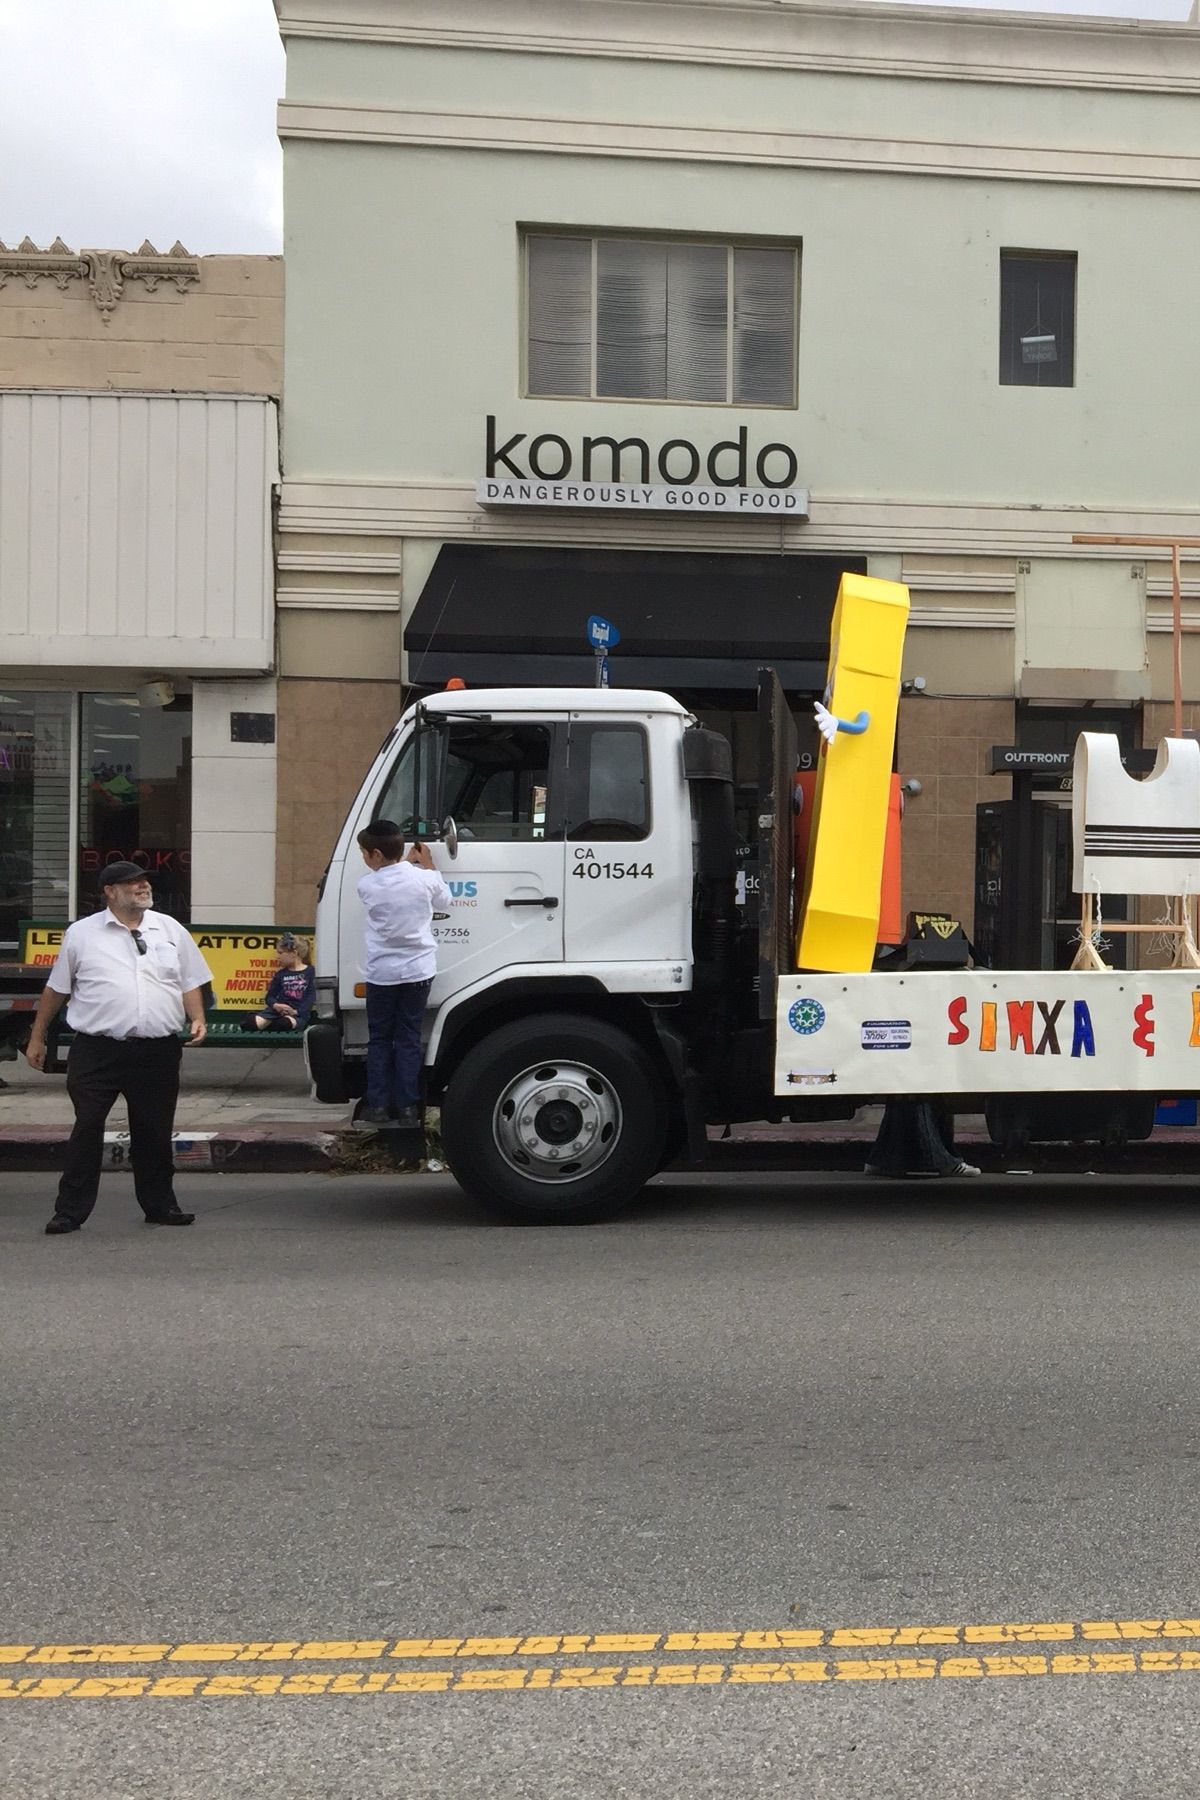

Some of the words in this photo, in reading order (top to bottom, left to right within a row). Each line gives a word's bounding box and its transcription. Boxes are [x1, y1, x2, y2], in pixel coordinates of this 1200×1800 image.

[485, 415, 799, 489] komodo
[487, 483, 654, 504] DANGEROUSLY
[665, 490, 727, 506] GOOD
[739, 492, 798, 509] FOOD
[1004, 752, 1070, 764] OUTFRONT
[574, 847, 595, 860] CA
[572, 862, 655, 880] 401544
[449, 881, 478, 898] US
[449, 900, 478, 908] ATING
[433, 928, 470, 937] 3-7556
[198, 935, 279, 950] ATTOR
[249, 959, 267, 968] YOU
[223, 997, 265, 1005] WWW.4LE
[947, 995, 1097, 1058] SIMXA
